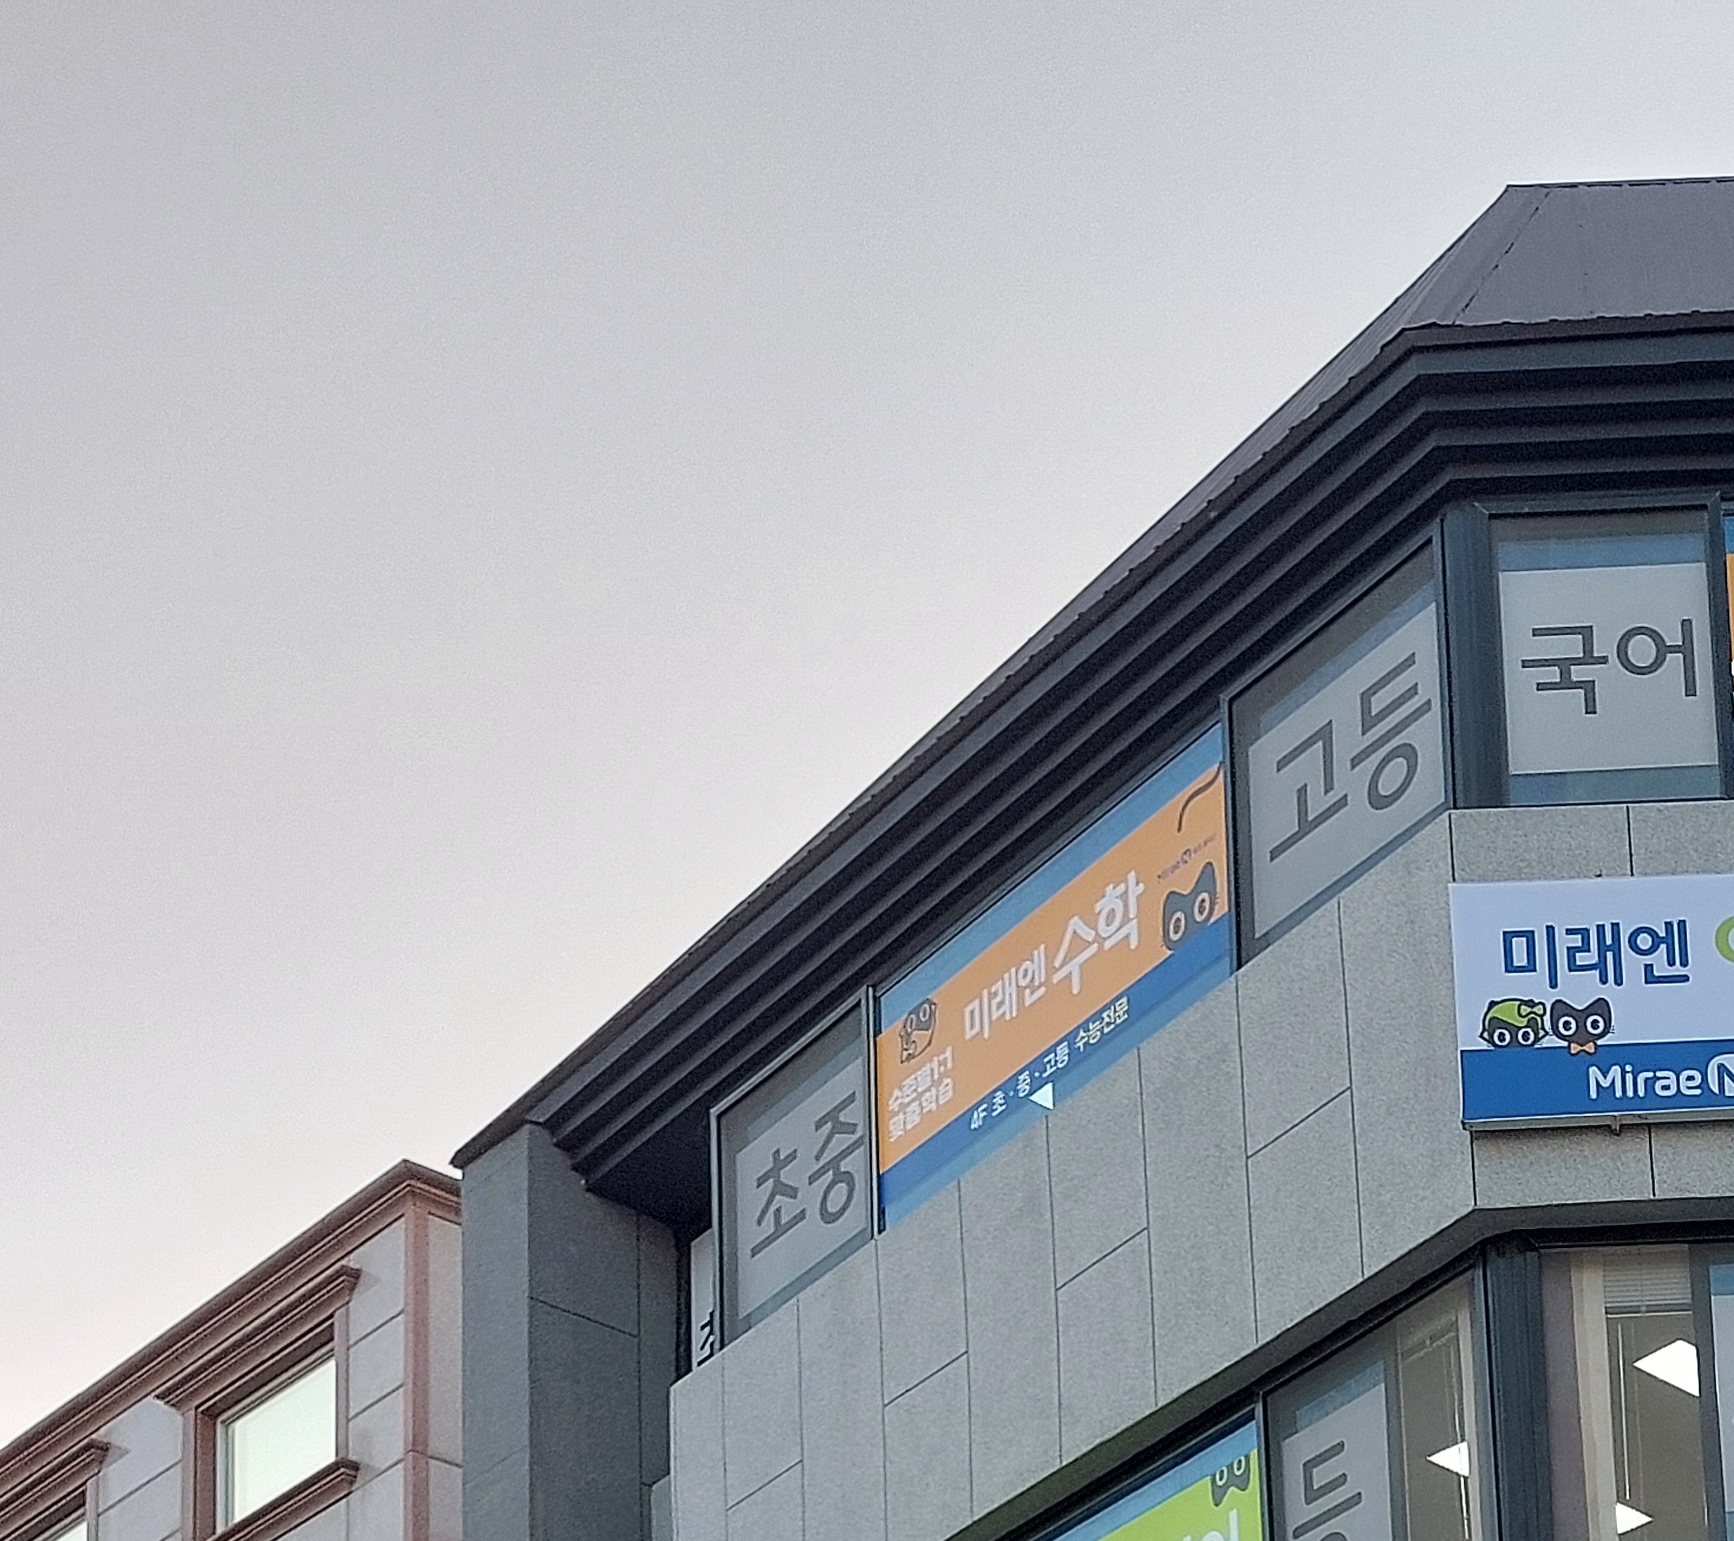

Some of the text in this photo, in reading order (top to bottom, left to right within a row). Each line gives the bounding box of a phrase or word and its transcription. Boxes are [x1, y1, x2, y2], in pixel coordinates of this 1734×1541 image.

[1520, 618, 1698, 714] 국어
[1269, 651, 1432, 862] 고등
[964, 870, 1146, 1042] 미래엔 수학
[1501, 918, 1691, 990] 미래엔
[970, 996, 1129, 1132] 4F 수능전문
[750, 1090, 865, 1260] 초중
